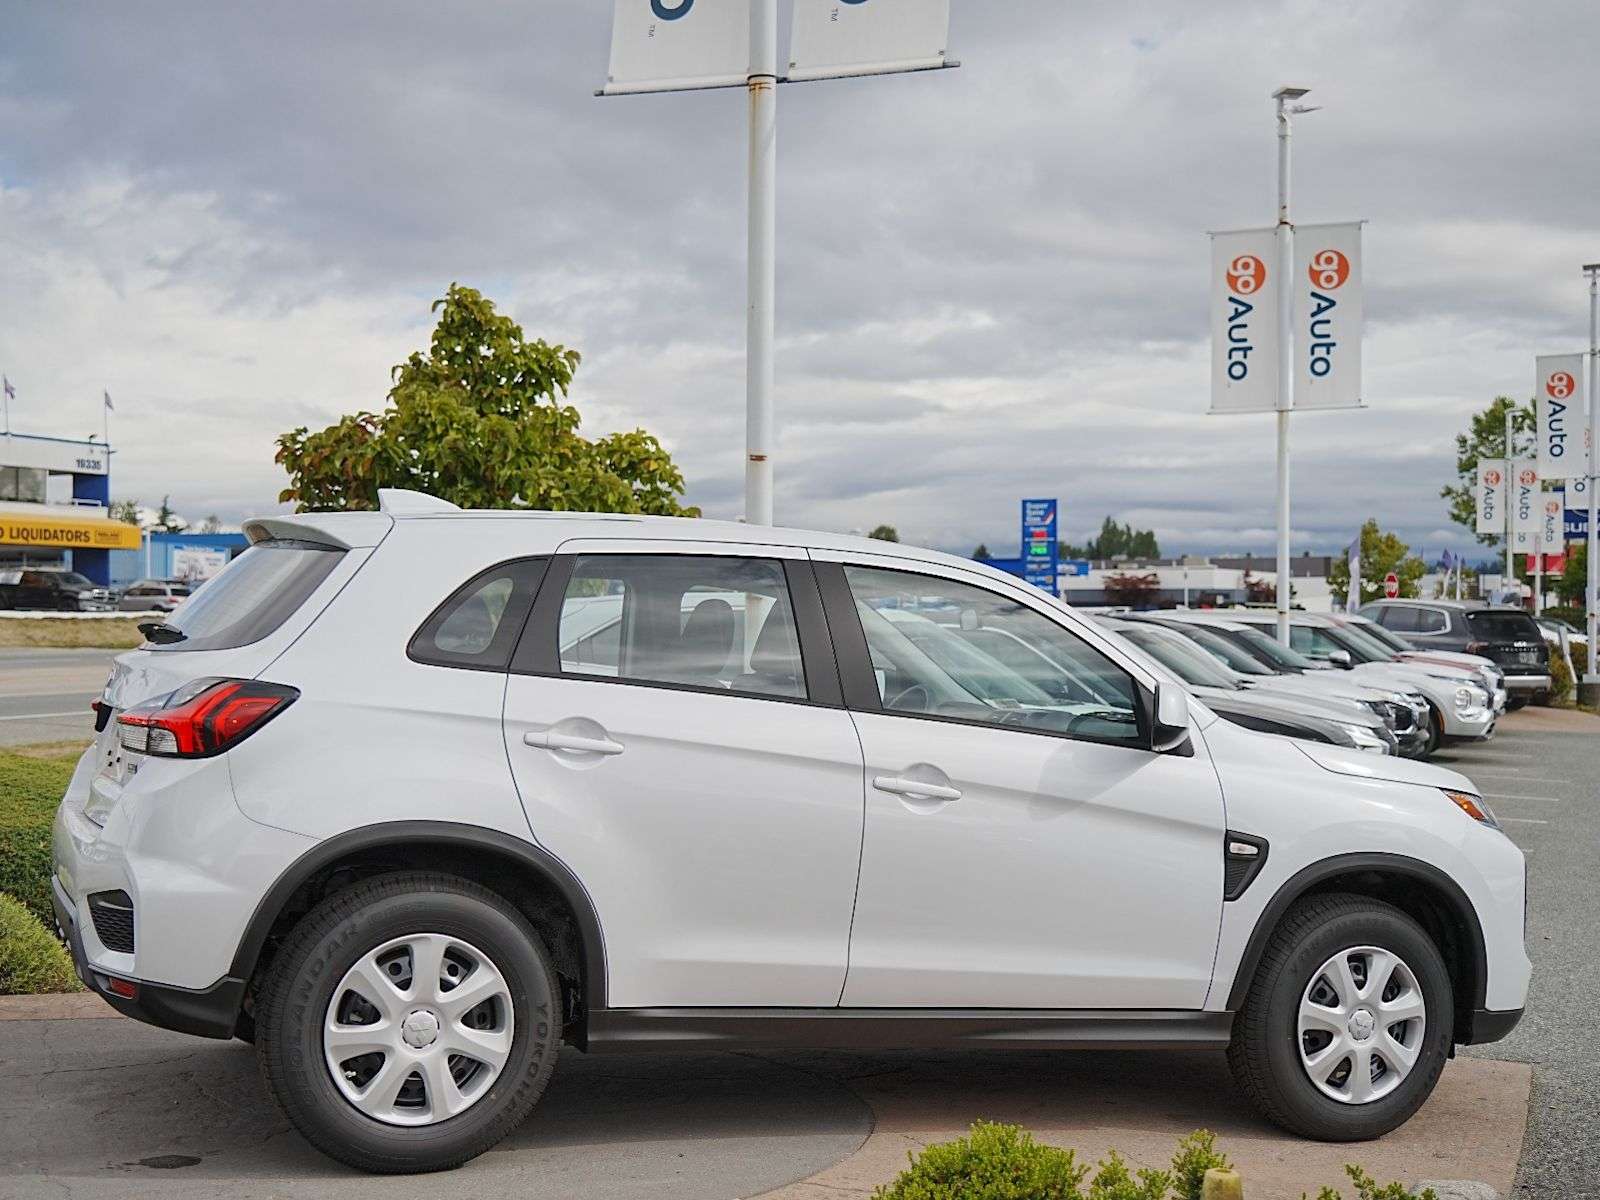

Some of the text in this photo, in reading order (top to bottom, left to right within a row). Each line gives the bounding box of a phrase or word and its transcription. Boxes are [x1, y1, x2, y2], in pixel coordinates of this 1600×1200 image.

[1227, 296, 1254, 381] Auto
[1310, 291, 1337, 377] Auto
[1548, 400, 1567, 457] Auto
[1483, 486, 1495, 520] Auto
[1520, 486, 1531, 520] Auto
[9, 527, 90, 543] LIQUIDATORS
[480, 1002, 548, 1133] YOKOHA
